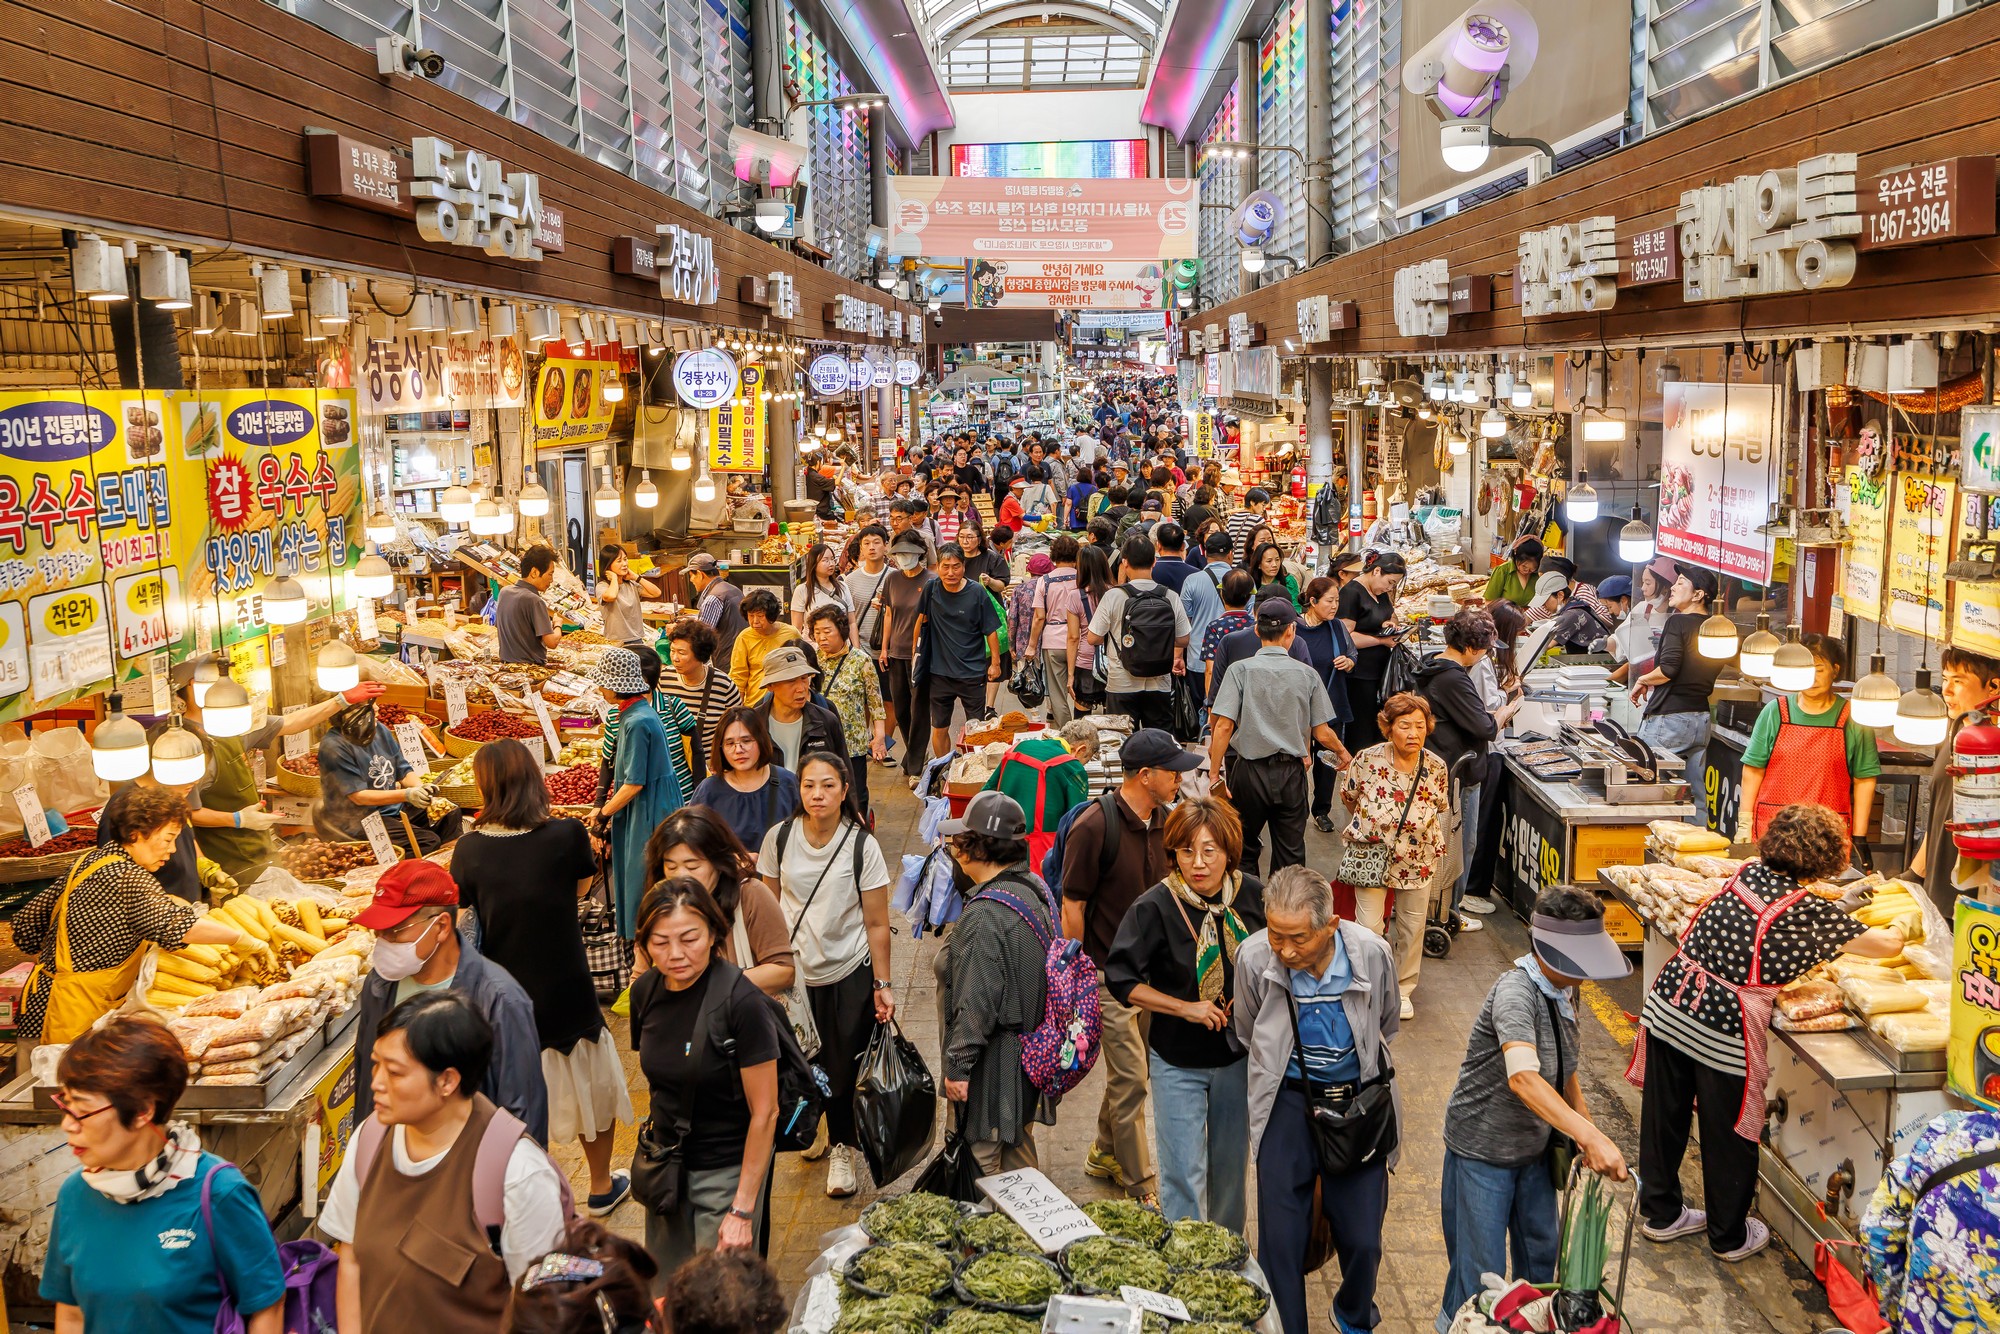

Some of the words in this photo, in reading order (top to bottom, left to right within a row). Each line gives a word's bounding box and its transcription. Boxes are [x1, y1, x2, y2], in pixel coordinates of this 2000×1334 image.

[1878, 176, 1917, 206] 옥수수
[1920, 165, 1948, 199] 전문
[1870, 200, 1950, 244] T.967-3964
[1632, 234, 1651, 256] 농산물
[1652, 231, 1666, 251] 전문
[656, 224, 714, 305] 경동상사
[1042, 263, 1071, 276] 안녕히
[1074, 264, 1104, 276] 가세요
[1635, 256, 1668, 281] 963-5947
[1048, 294, 1094, 306] 감사합니다.
[1081, 280, 1107, 291] 방문해
[682, 371, 728, 386] 경동상사
[743, 370, 757, 382] 냉
[0, 416, 41, 448] 30년
[43, 414, 103, 446] 전통맛집
[236, 412, 263, 436] 30년
[264, 410, 305, 434] 전통맛집
[214, 465, 243, 519] 찰
[257, 452, 338, 520] 옥수수
[205, 526, 276, 596] 맛있게
[325, 515, 348, 567] 집
[52, 597, 94, 629] 작은거
